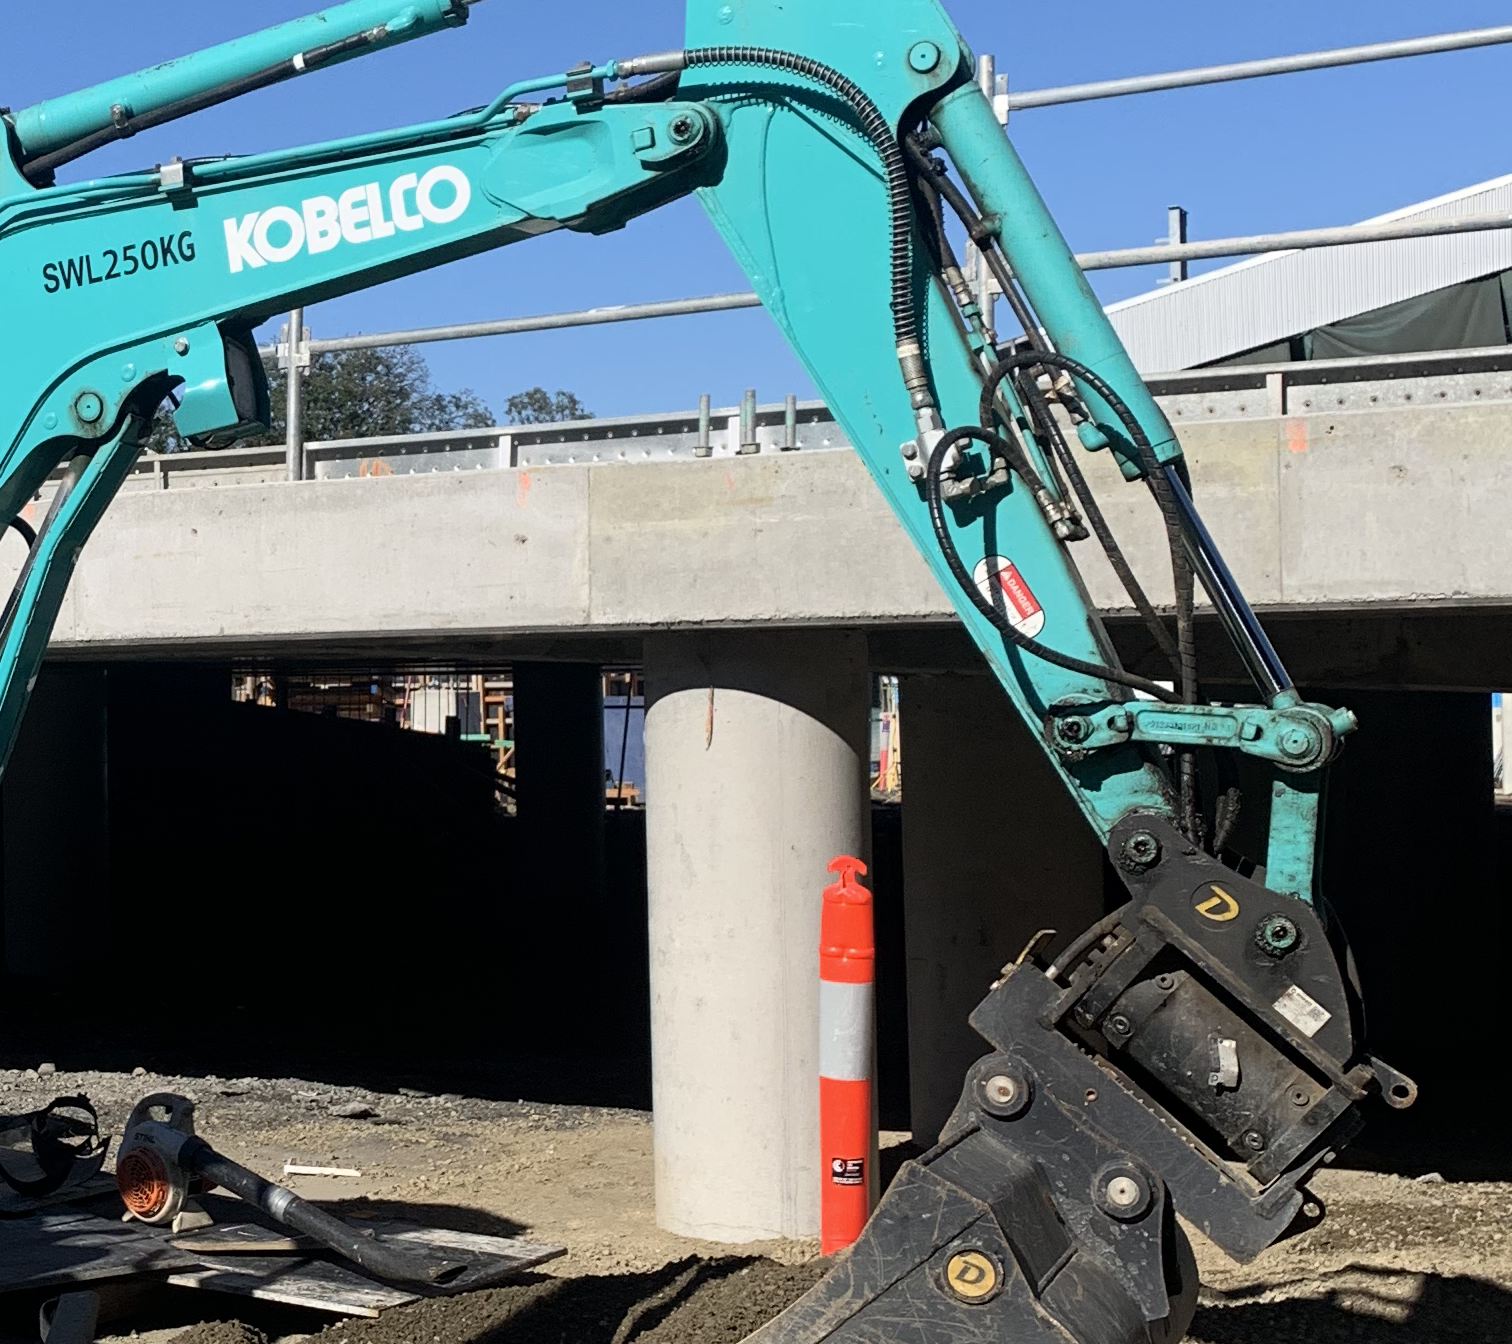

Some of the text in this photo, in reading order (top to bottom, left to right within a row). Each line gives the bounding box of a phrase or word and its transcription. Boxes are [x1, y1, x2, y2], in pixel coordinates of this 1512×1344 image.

[223, 165, 472, 274] KOBELCO
[42, 230, 196, 294] SWL250KG
[1006, 578, 1035, 616] DANGER
